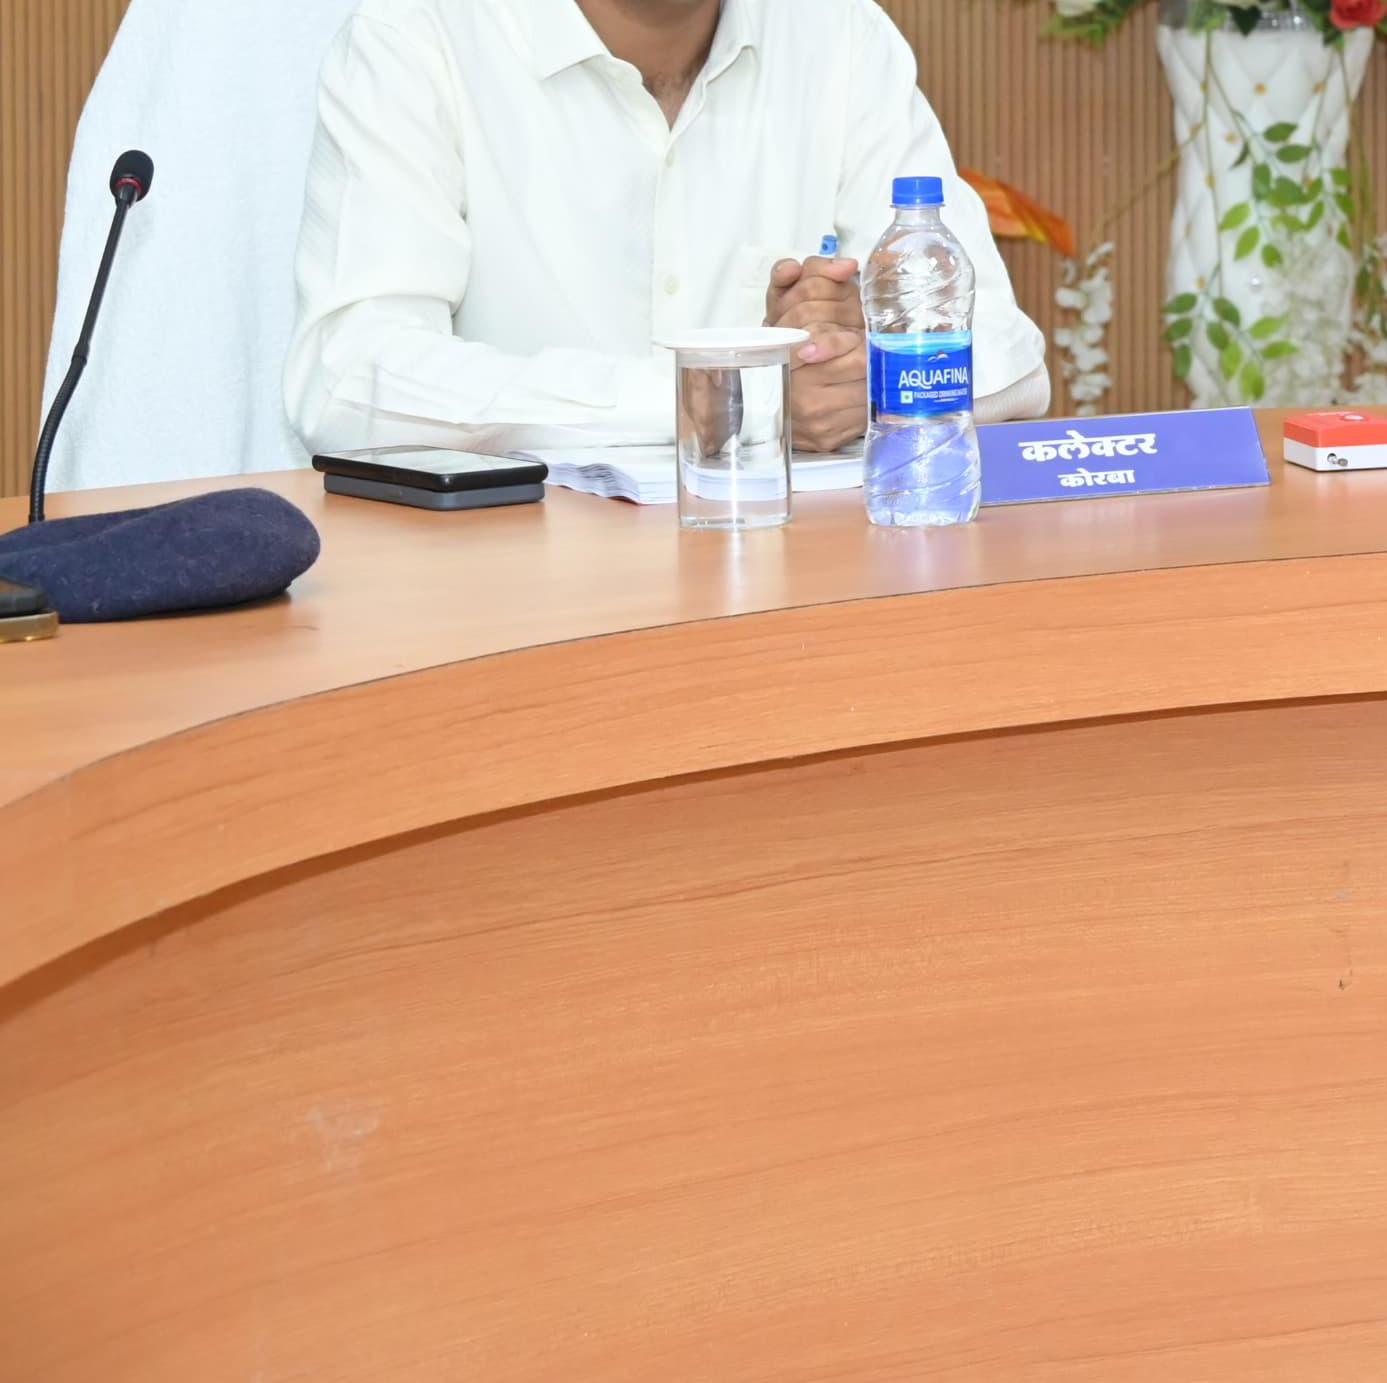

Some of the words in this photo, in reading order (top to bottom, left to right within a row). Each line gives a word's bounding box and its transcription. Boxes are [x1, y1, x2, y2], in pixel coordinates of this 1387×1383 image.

[898, 367, 969, 390] AQUAFINA
[1018, 430, 1158, 464] कलेक्टर
[1057, 467, 1136, 489] कोरबा
